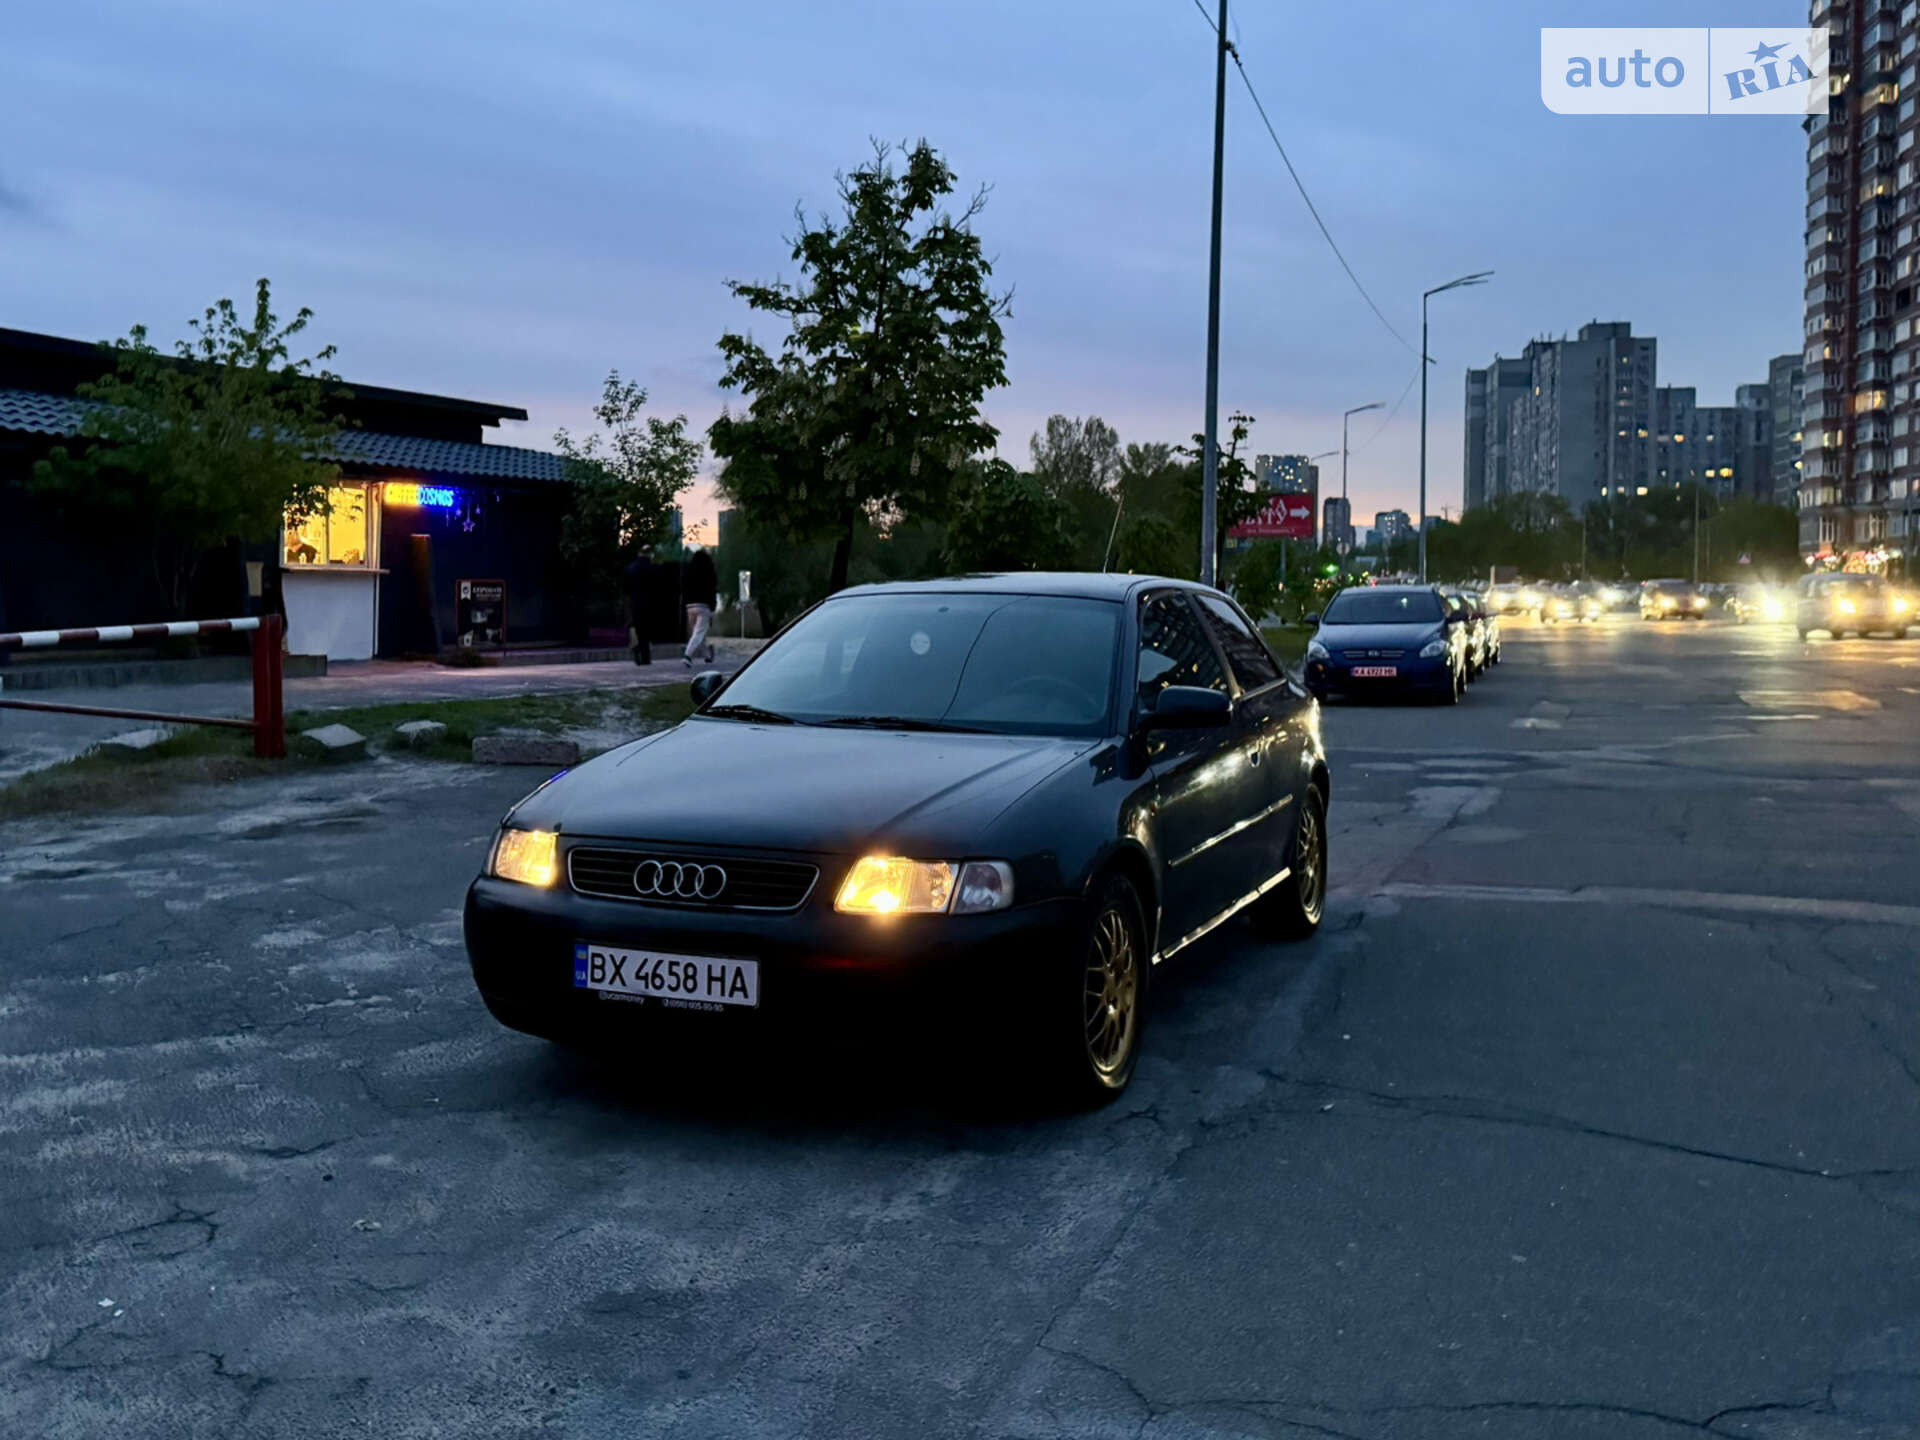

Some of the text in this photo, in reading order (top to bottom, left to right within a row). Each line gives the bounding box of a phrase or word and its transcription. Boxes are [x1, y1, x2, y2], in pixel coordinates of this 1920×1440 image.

[590, 952, 749, 999] BX 4658 HA
